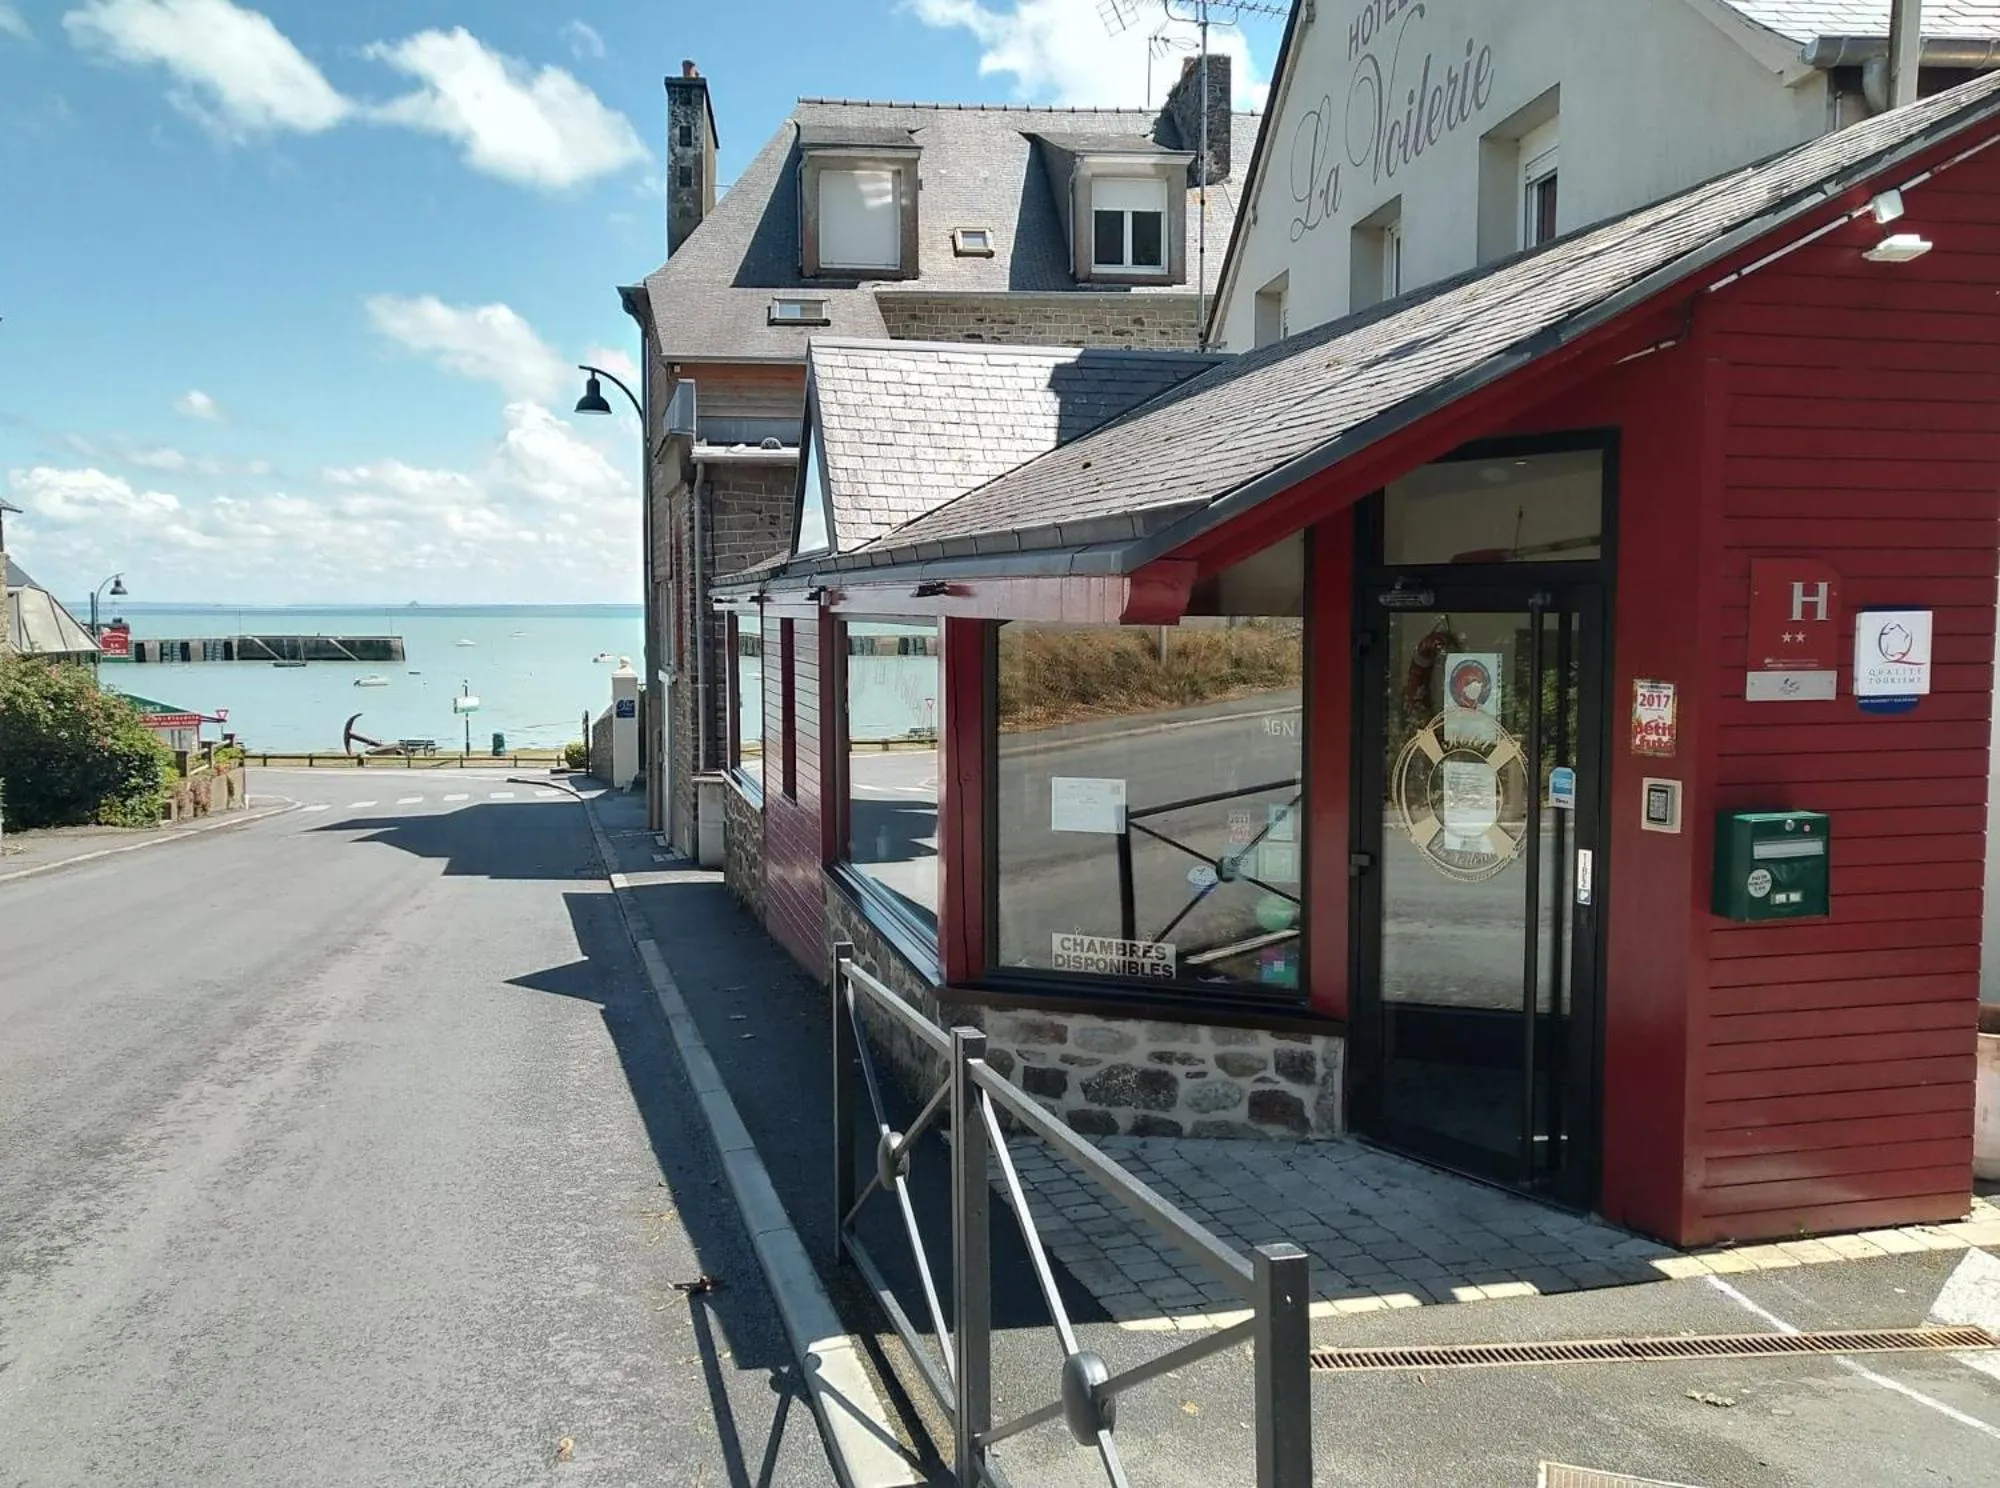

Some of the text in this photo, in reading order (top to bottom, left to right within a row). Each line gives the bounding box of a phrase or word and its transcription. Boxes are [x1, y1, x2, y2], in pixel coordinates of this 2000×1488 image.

[1348, 0, 1408, 61] HOTE
[1290, 3, 1495, 243] La Voilerie
[1787, 581, 1832, 621] H
[1638, 693, 1671, 708] 2017
[1060, 937, 1167, 960] CHAMBRES
[1053, 954, 1174, 978] DISPONIBLES
